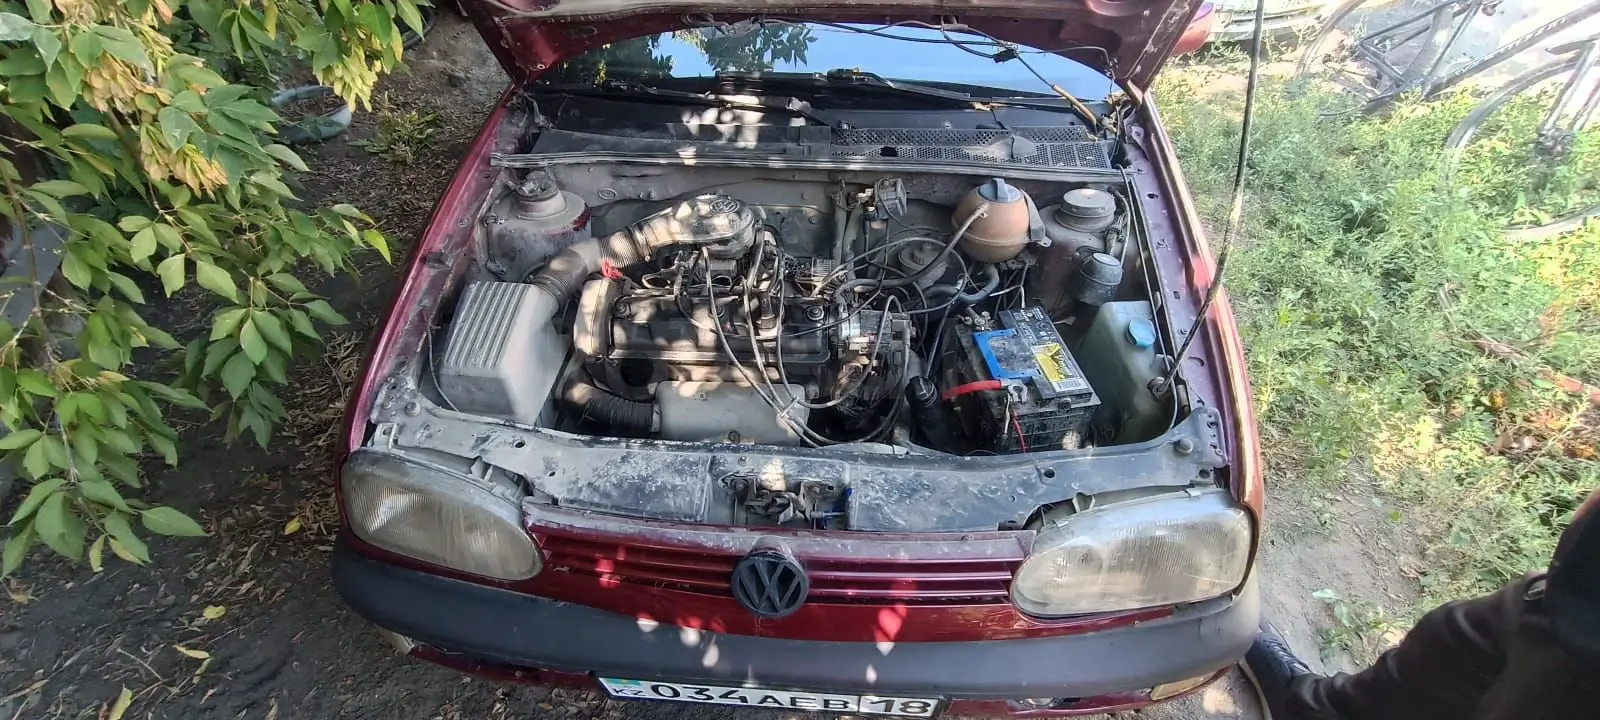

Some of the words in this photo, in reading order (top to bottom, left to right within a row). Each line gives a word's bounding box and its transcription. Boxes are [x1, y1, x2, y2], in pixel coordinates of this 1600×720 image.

[733, 555, 807, 616] VW
[612, 687, 647, 697] KZ
[864, 699, 931, 714] 18
